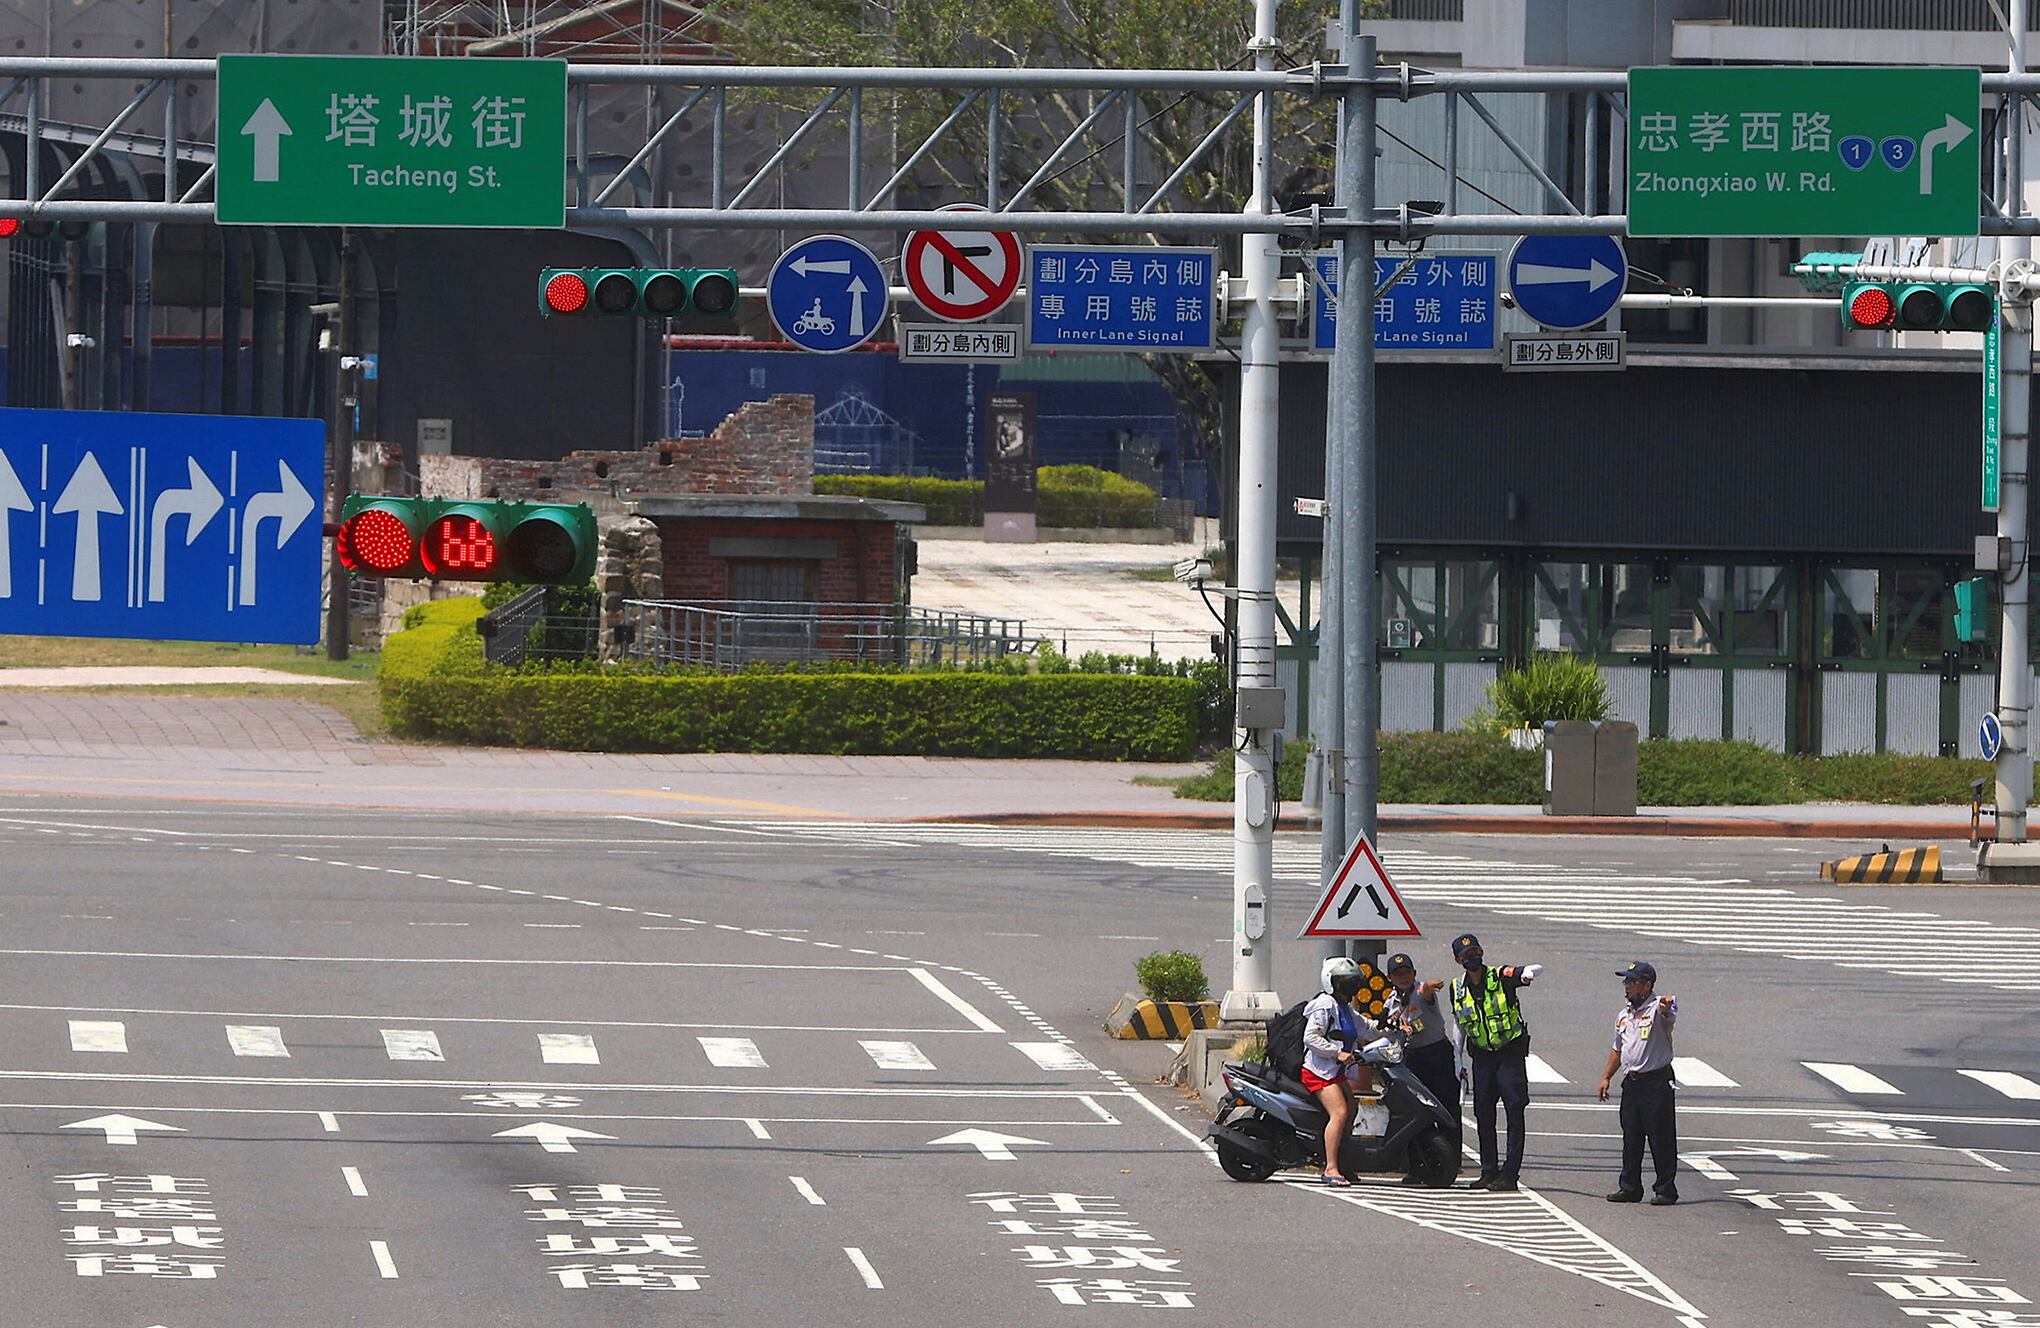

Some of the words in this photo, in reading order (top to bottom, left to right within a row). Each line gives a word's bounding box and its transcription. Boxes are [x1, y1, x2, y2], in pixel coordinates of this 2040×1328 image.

[325, 93, 526, 148] 塔城街
[1638, 111, 1833, 152] 忠孝西路
[1850, 144, 1861, 160] 1
[1893, 144, 1904, 160] 3
[347, 164, 457, 194] Tacheng
[468, 165, 501, 188] St.
[1636, 172, 1756, 198] Zhongxiao
[1766, 173, 1791, 192] W.
[1801, 173, 1836, 193] Rd.
[1039, 257, 1203, 286] 劃分島內側
[1039, 294, 1202, 322] 專用號誌
[912, 334, 1010, 353] 劃分島內側
[1058, 327, 1096, 340] Inner
[1100, 328, 1134, 340] Lane
[1138, 329, 1184, 344] Signal
[1384, 331, 1418, 342] Lane
[1422, 331, 1468, 345] Signal
[1516, 342, 1613, 362] 劃分島外側
